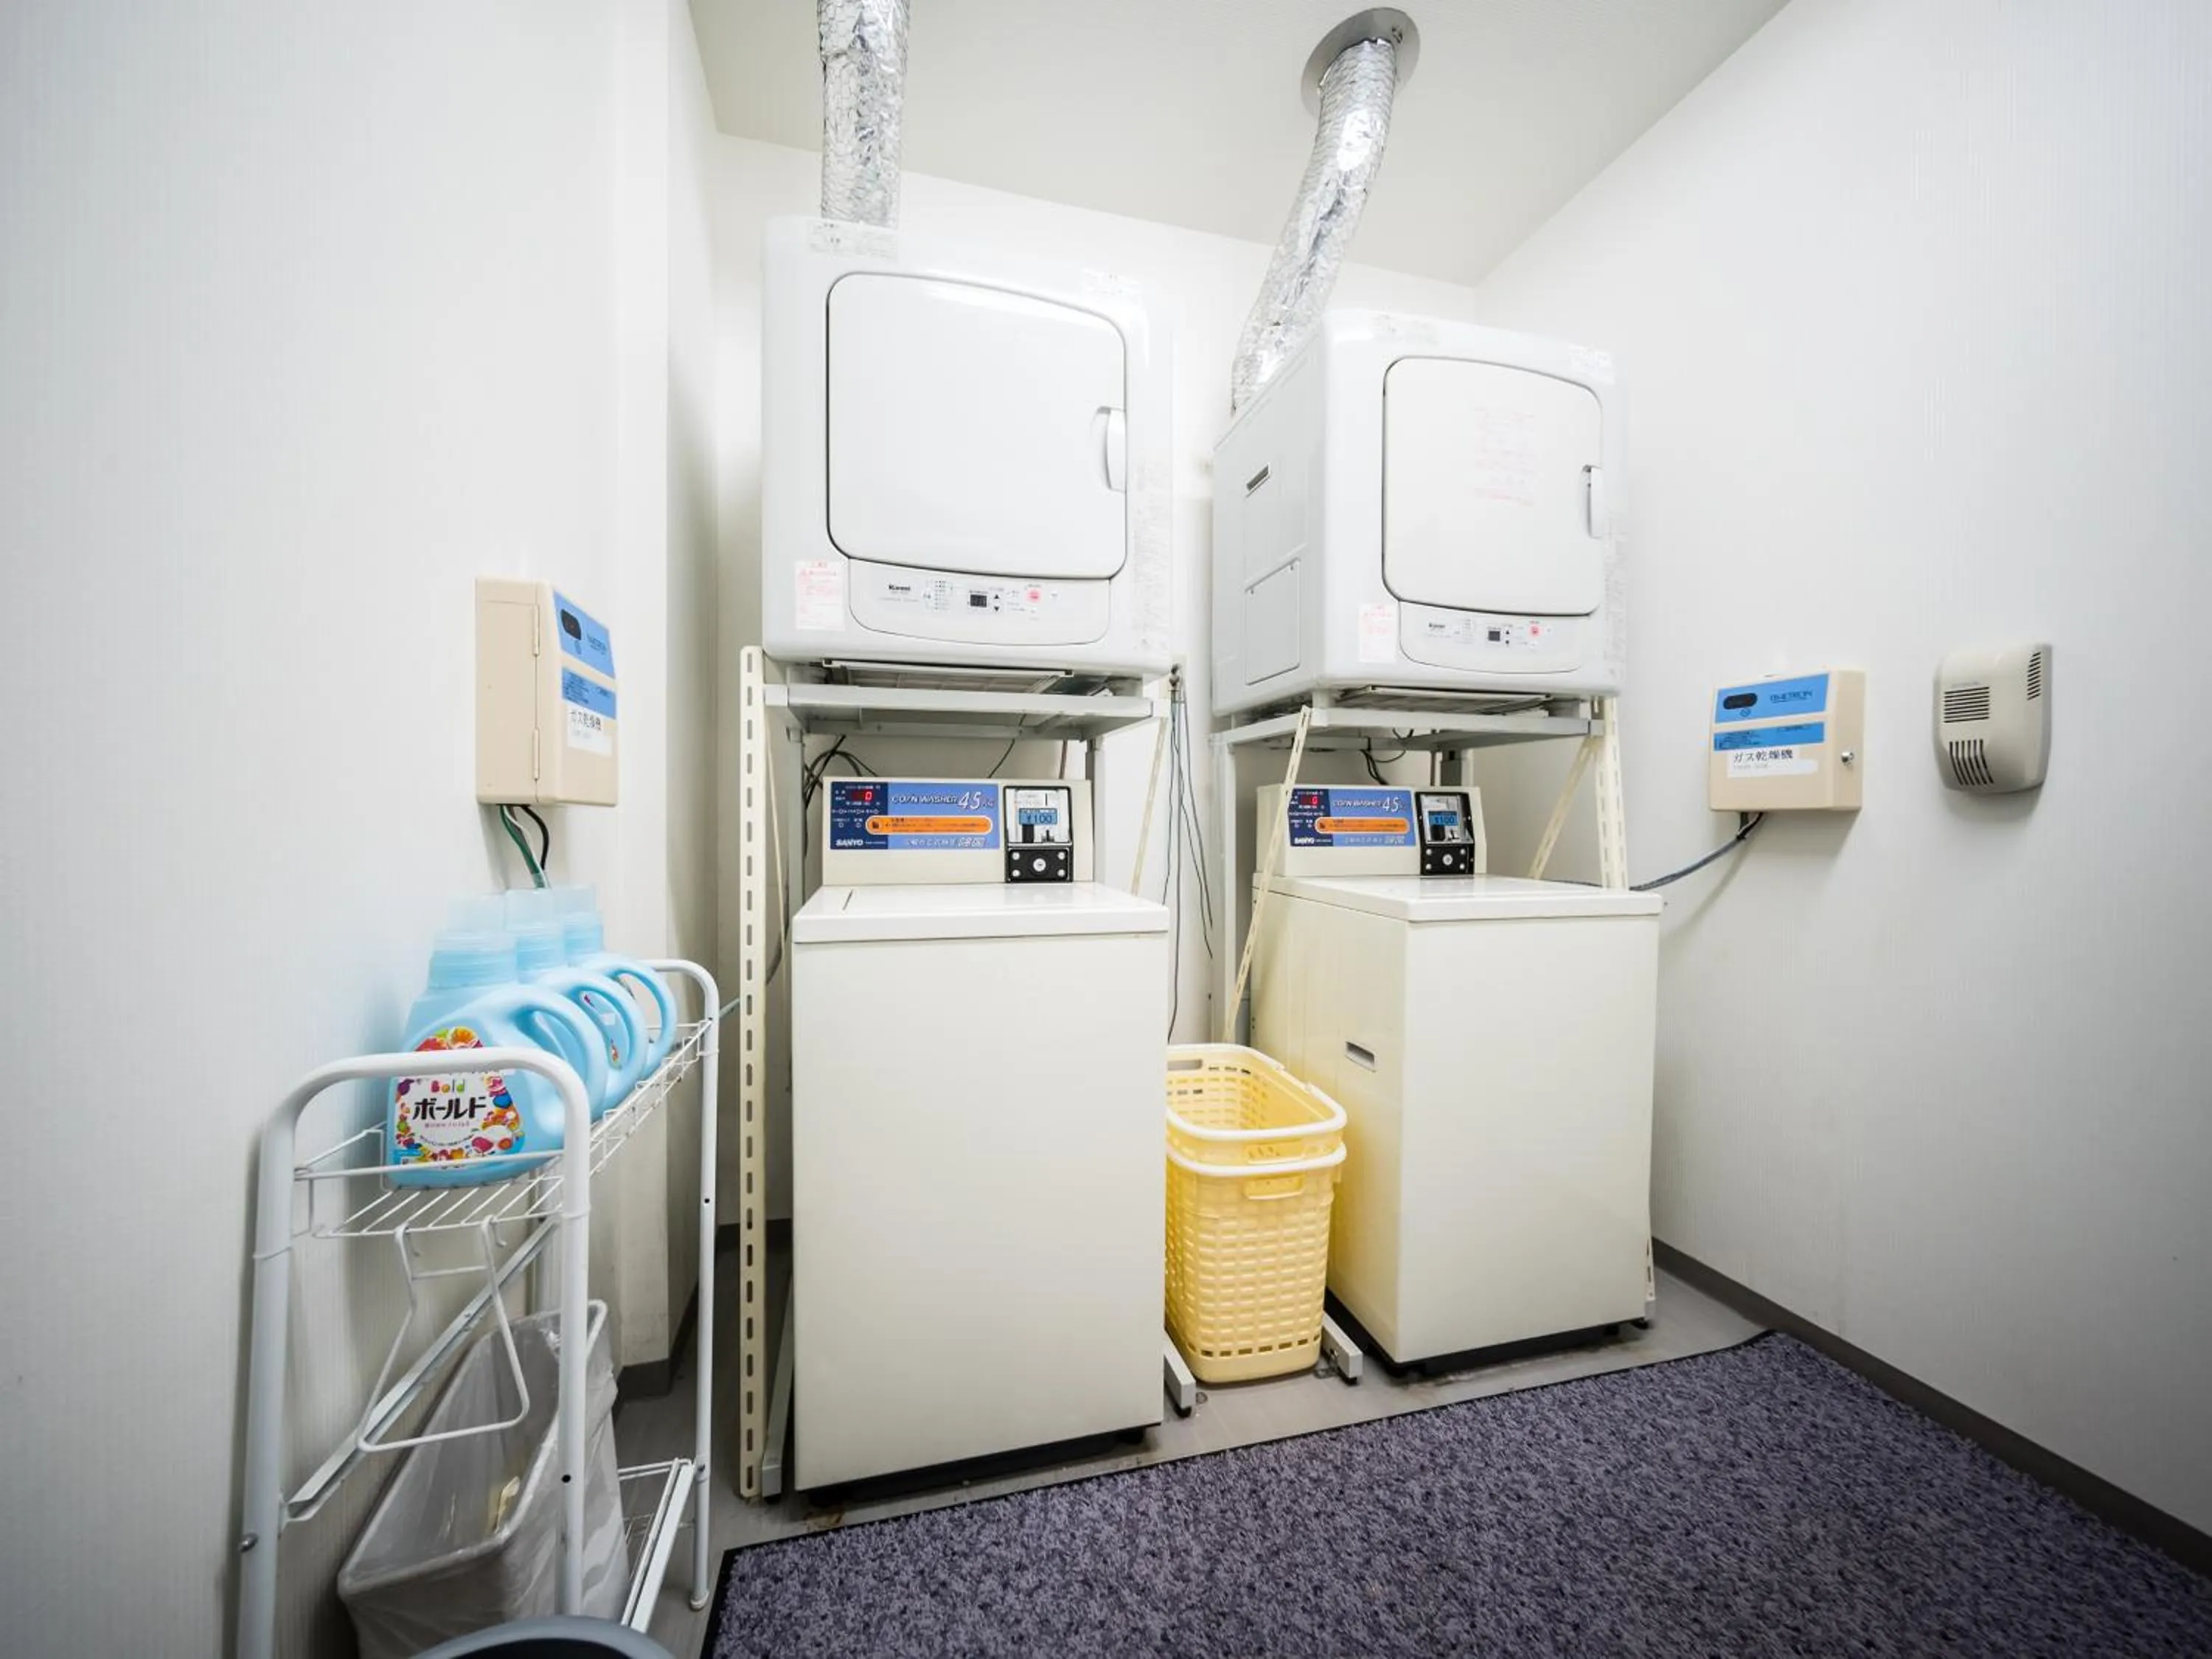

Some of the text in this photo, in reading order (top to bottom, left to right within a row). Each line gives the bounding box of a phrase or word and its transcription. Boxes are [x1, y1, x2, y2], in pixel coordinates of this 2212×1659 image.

[1733, 749, 1793, 762] ガス乾燥機
[431, 1079, 465, 1093] Bold
[412, 1096, 487, 1120] ボールド
